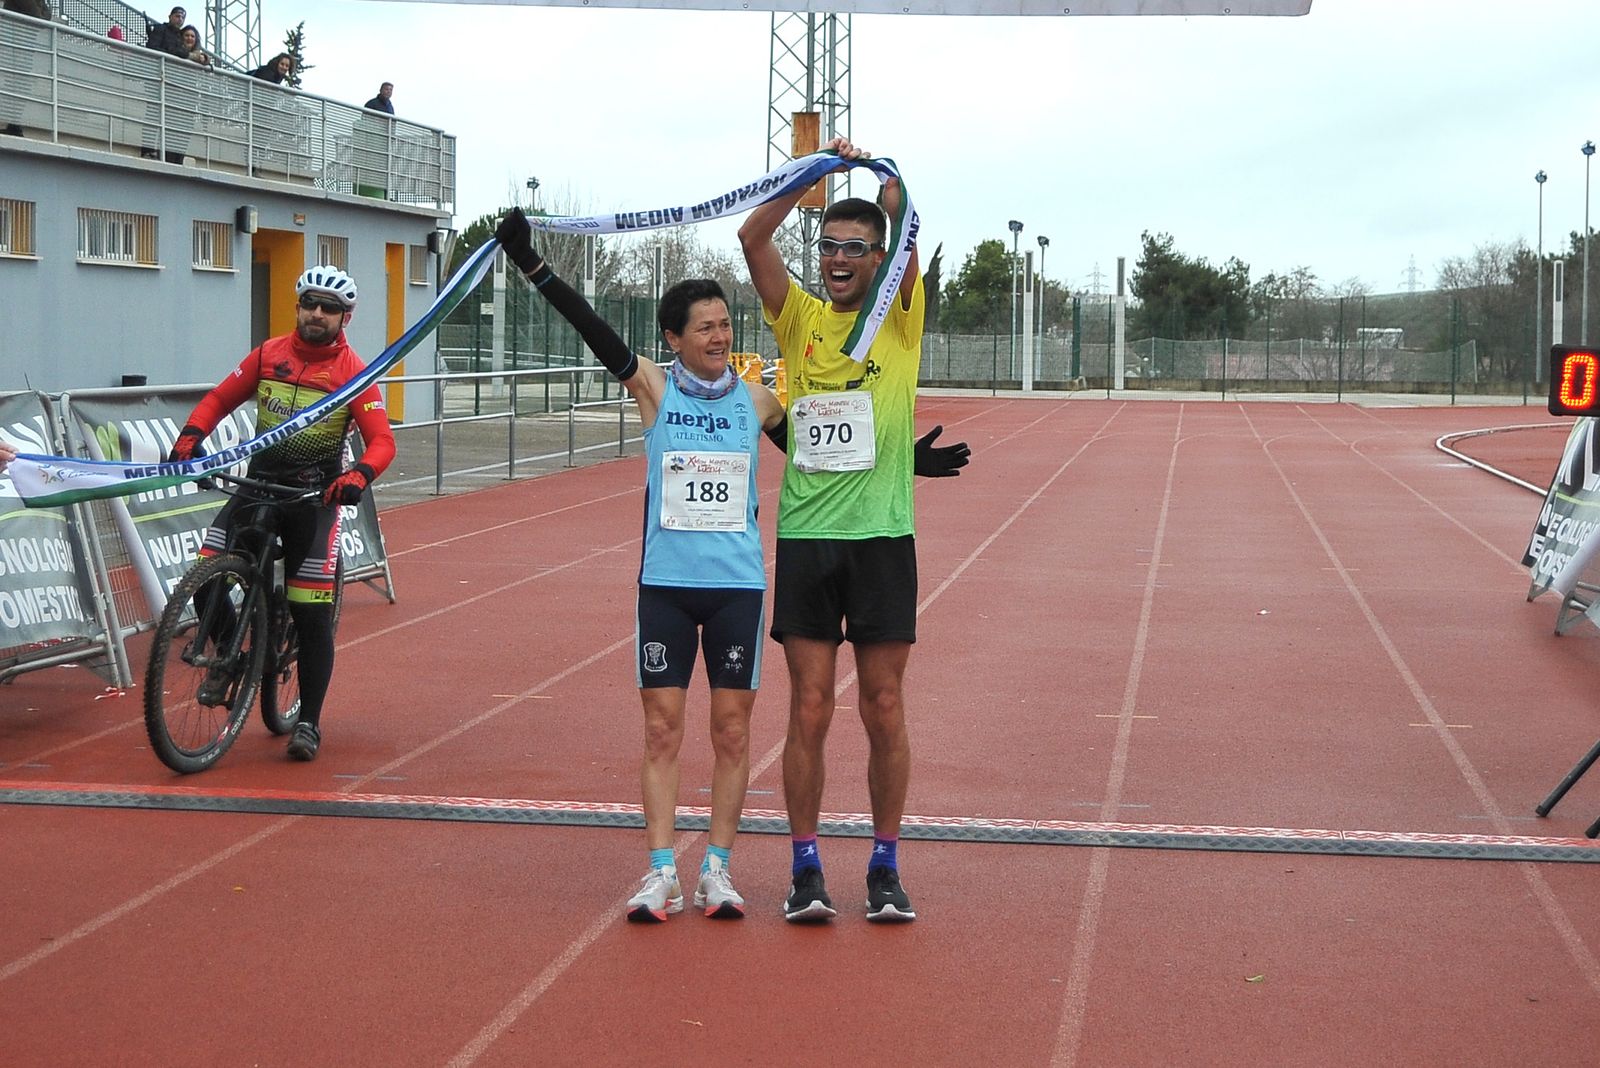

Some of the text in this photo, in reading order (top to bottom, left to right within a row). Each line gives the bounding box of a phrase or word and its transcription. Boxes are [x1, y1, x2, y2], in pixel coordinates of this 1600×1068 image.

[1559, 354, 1595, 406] 0
[666, 410, 732, 433] nerja
[674, 431, 724, 443] ATLETISMO
[809, 422, 853, 447] 970
[685, 481, 729, 503] 188
